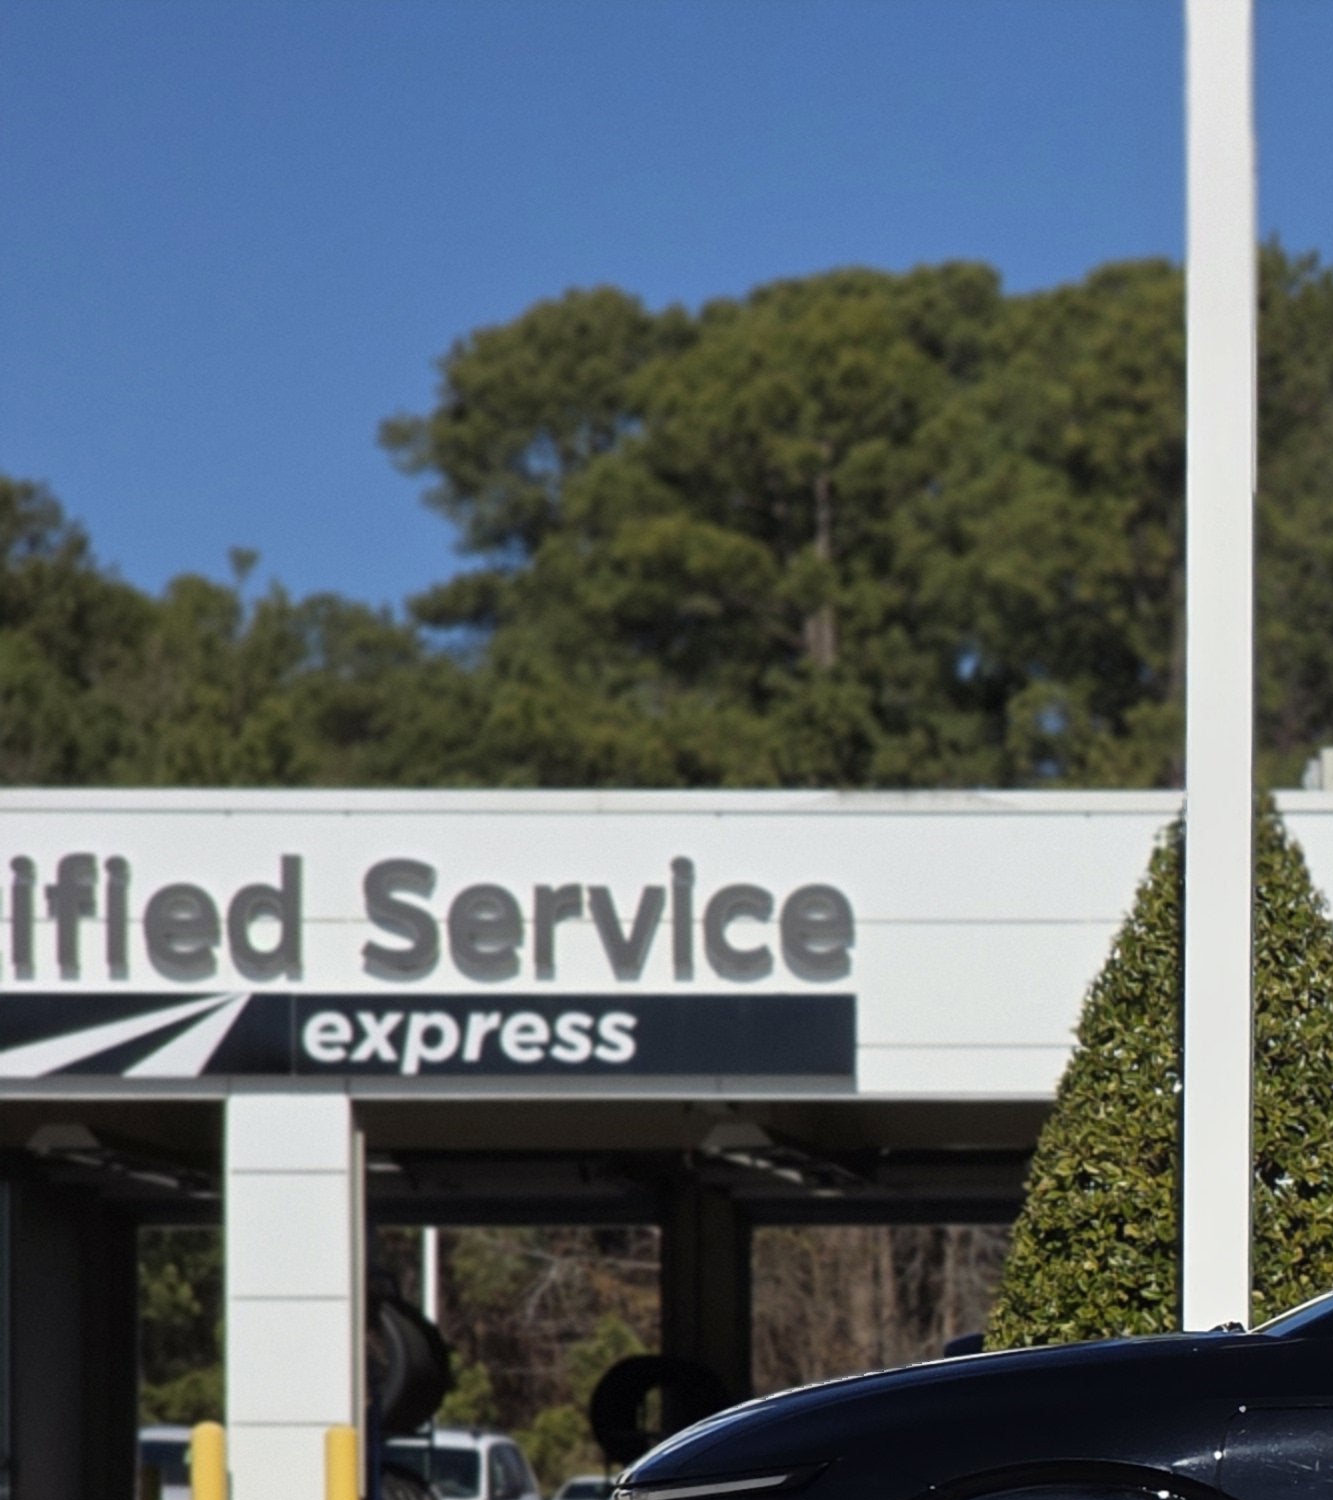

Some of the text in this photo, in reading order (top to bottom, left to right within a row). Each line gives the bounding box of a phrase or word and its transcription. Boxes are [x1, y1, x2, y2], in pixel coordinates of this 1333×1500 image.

[0, 851, 857, 983] ified Service
[302, 1007, 638, 1075] express
